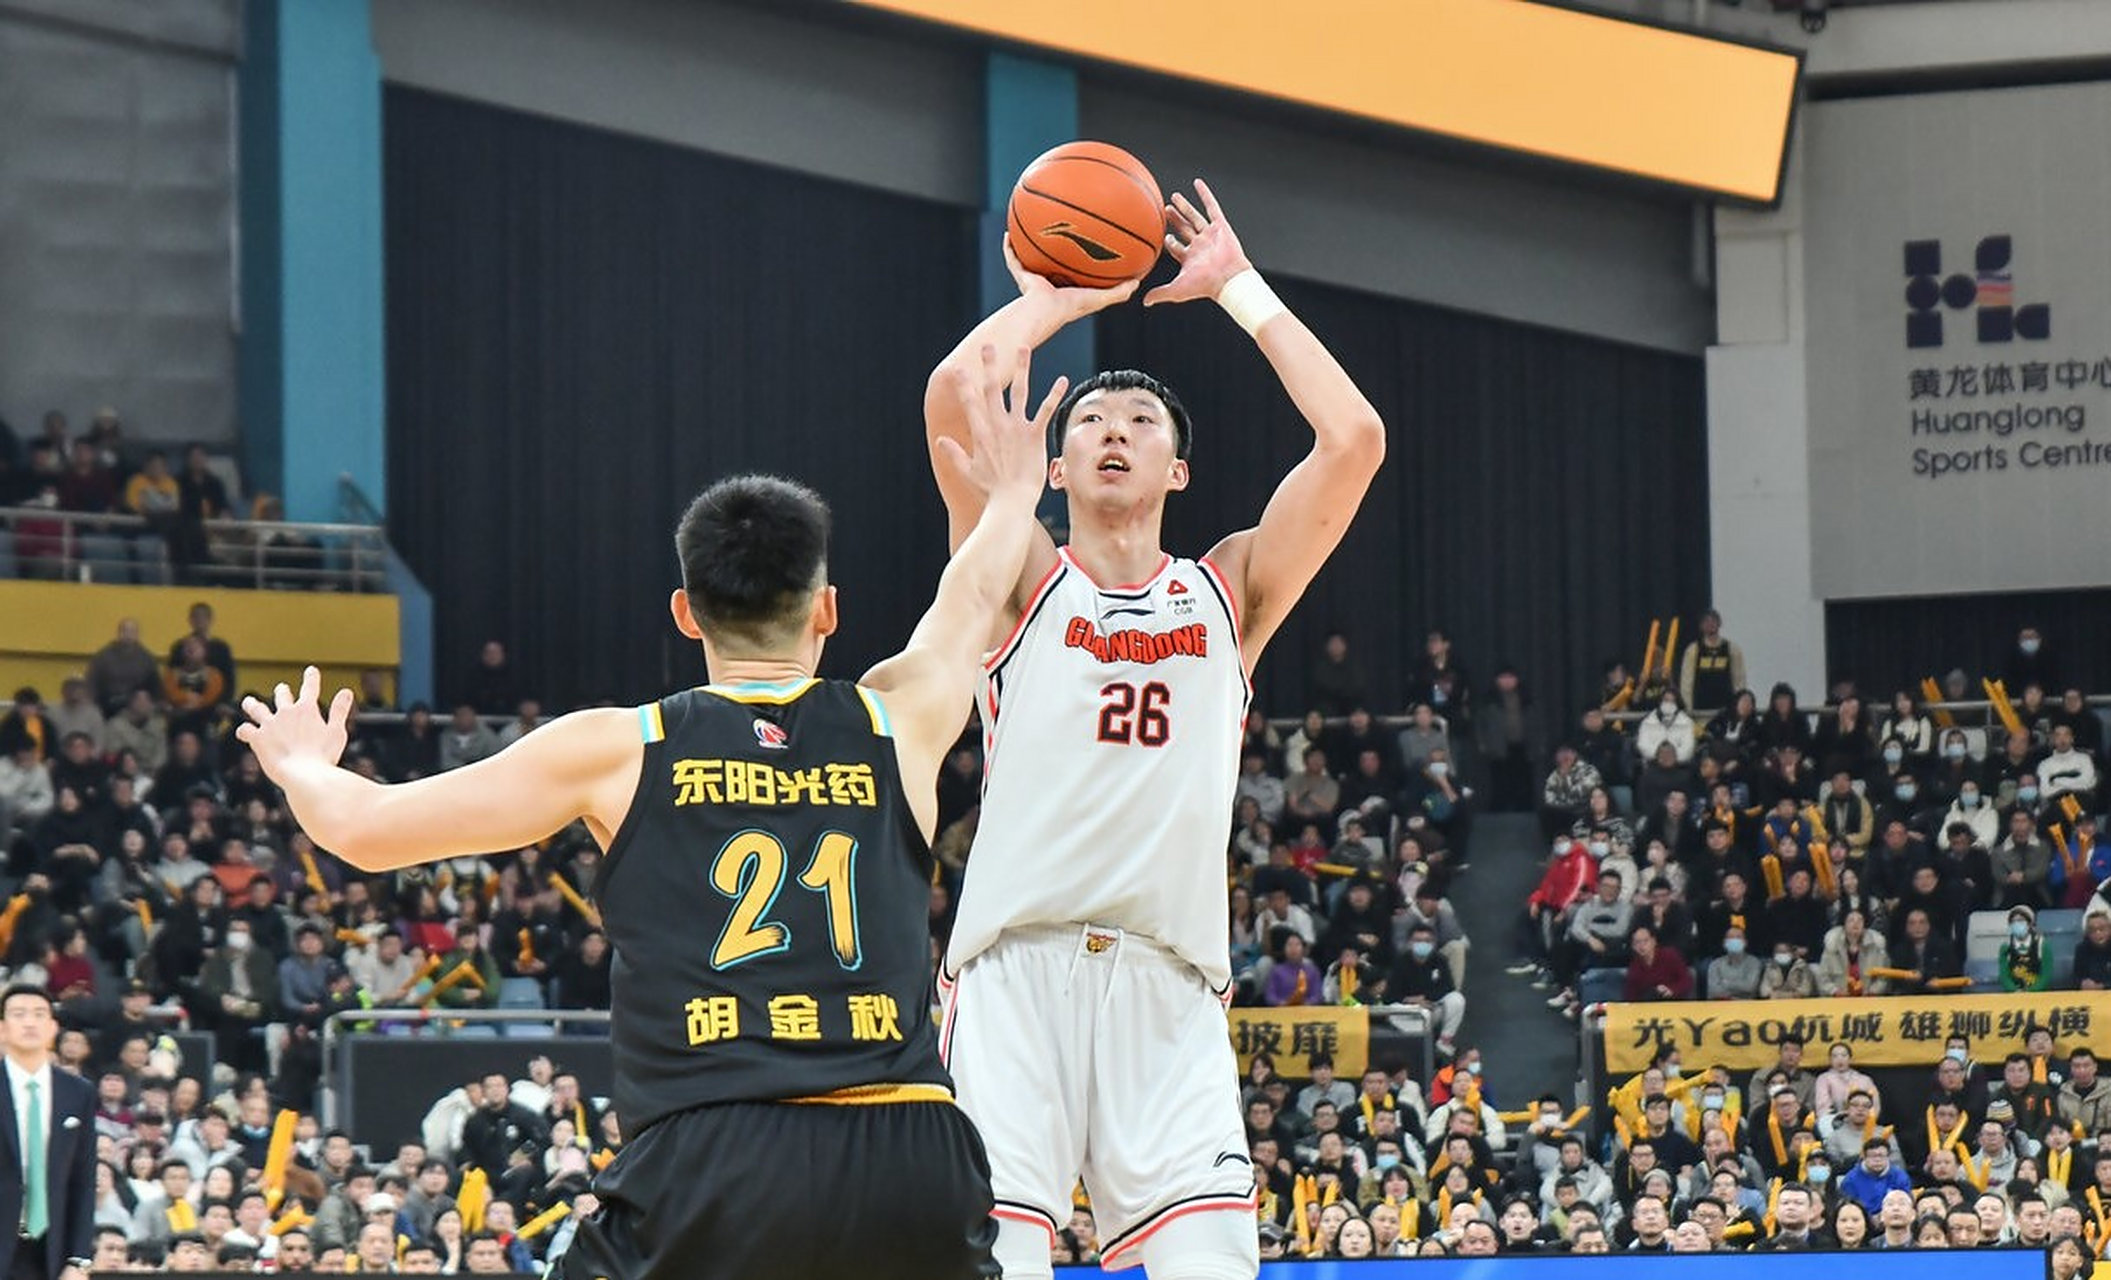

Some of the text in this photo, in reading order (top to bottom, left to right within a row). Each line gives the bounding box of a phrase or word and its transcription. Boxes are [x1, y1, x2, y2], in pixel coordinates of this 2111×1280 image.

[1911, 403, 2085, 436] Huanglong
[1912, 444, 2008, 480] Sports
[1097, 681, 1171, 748] 26
[672, 758, 877, 806] 东阳光药
[709, 828, 862, 971] 21
[684, 993, 904, 1046] 胡金秋
